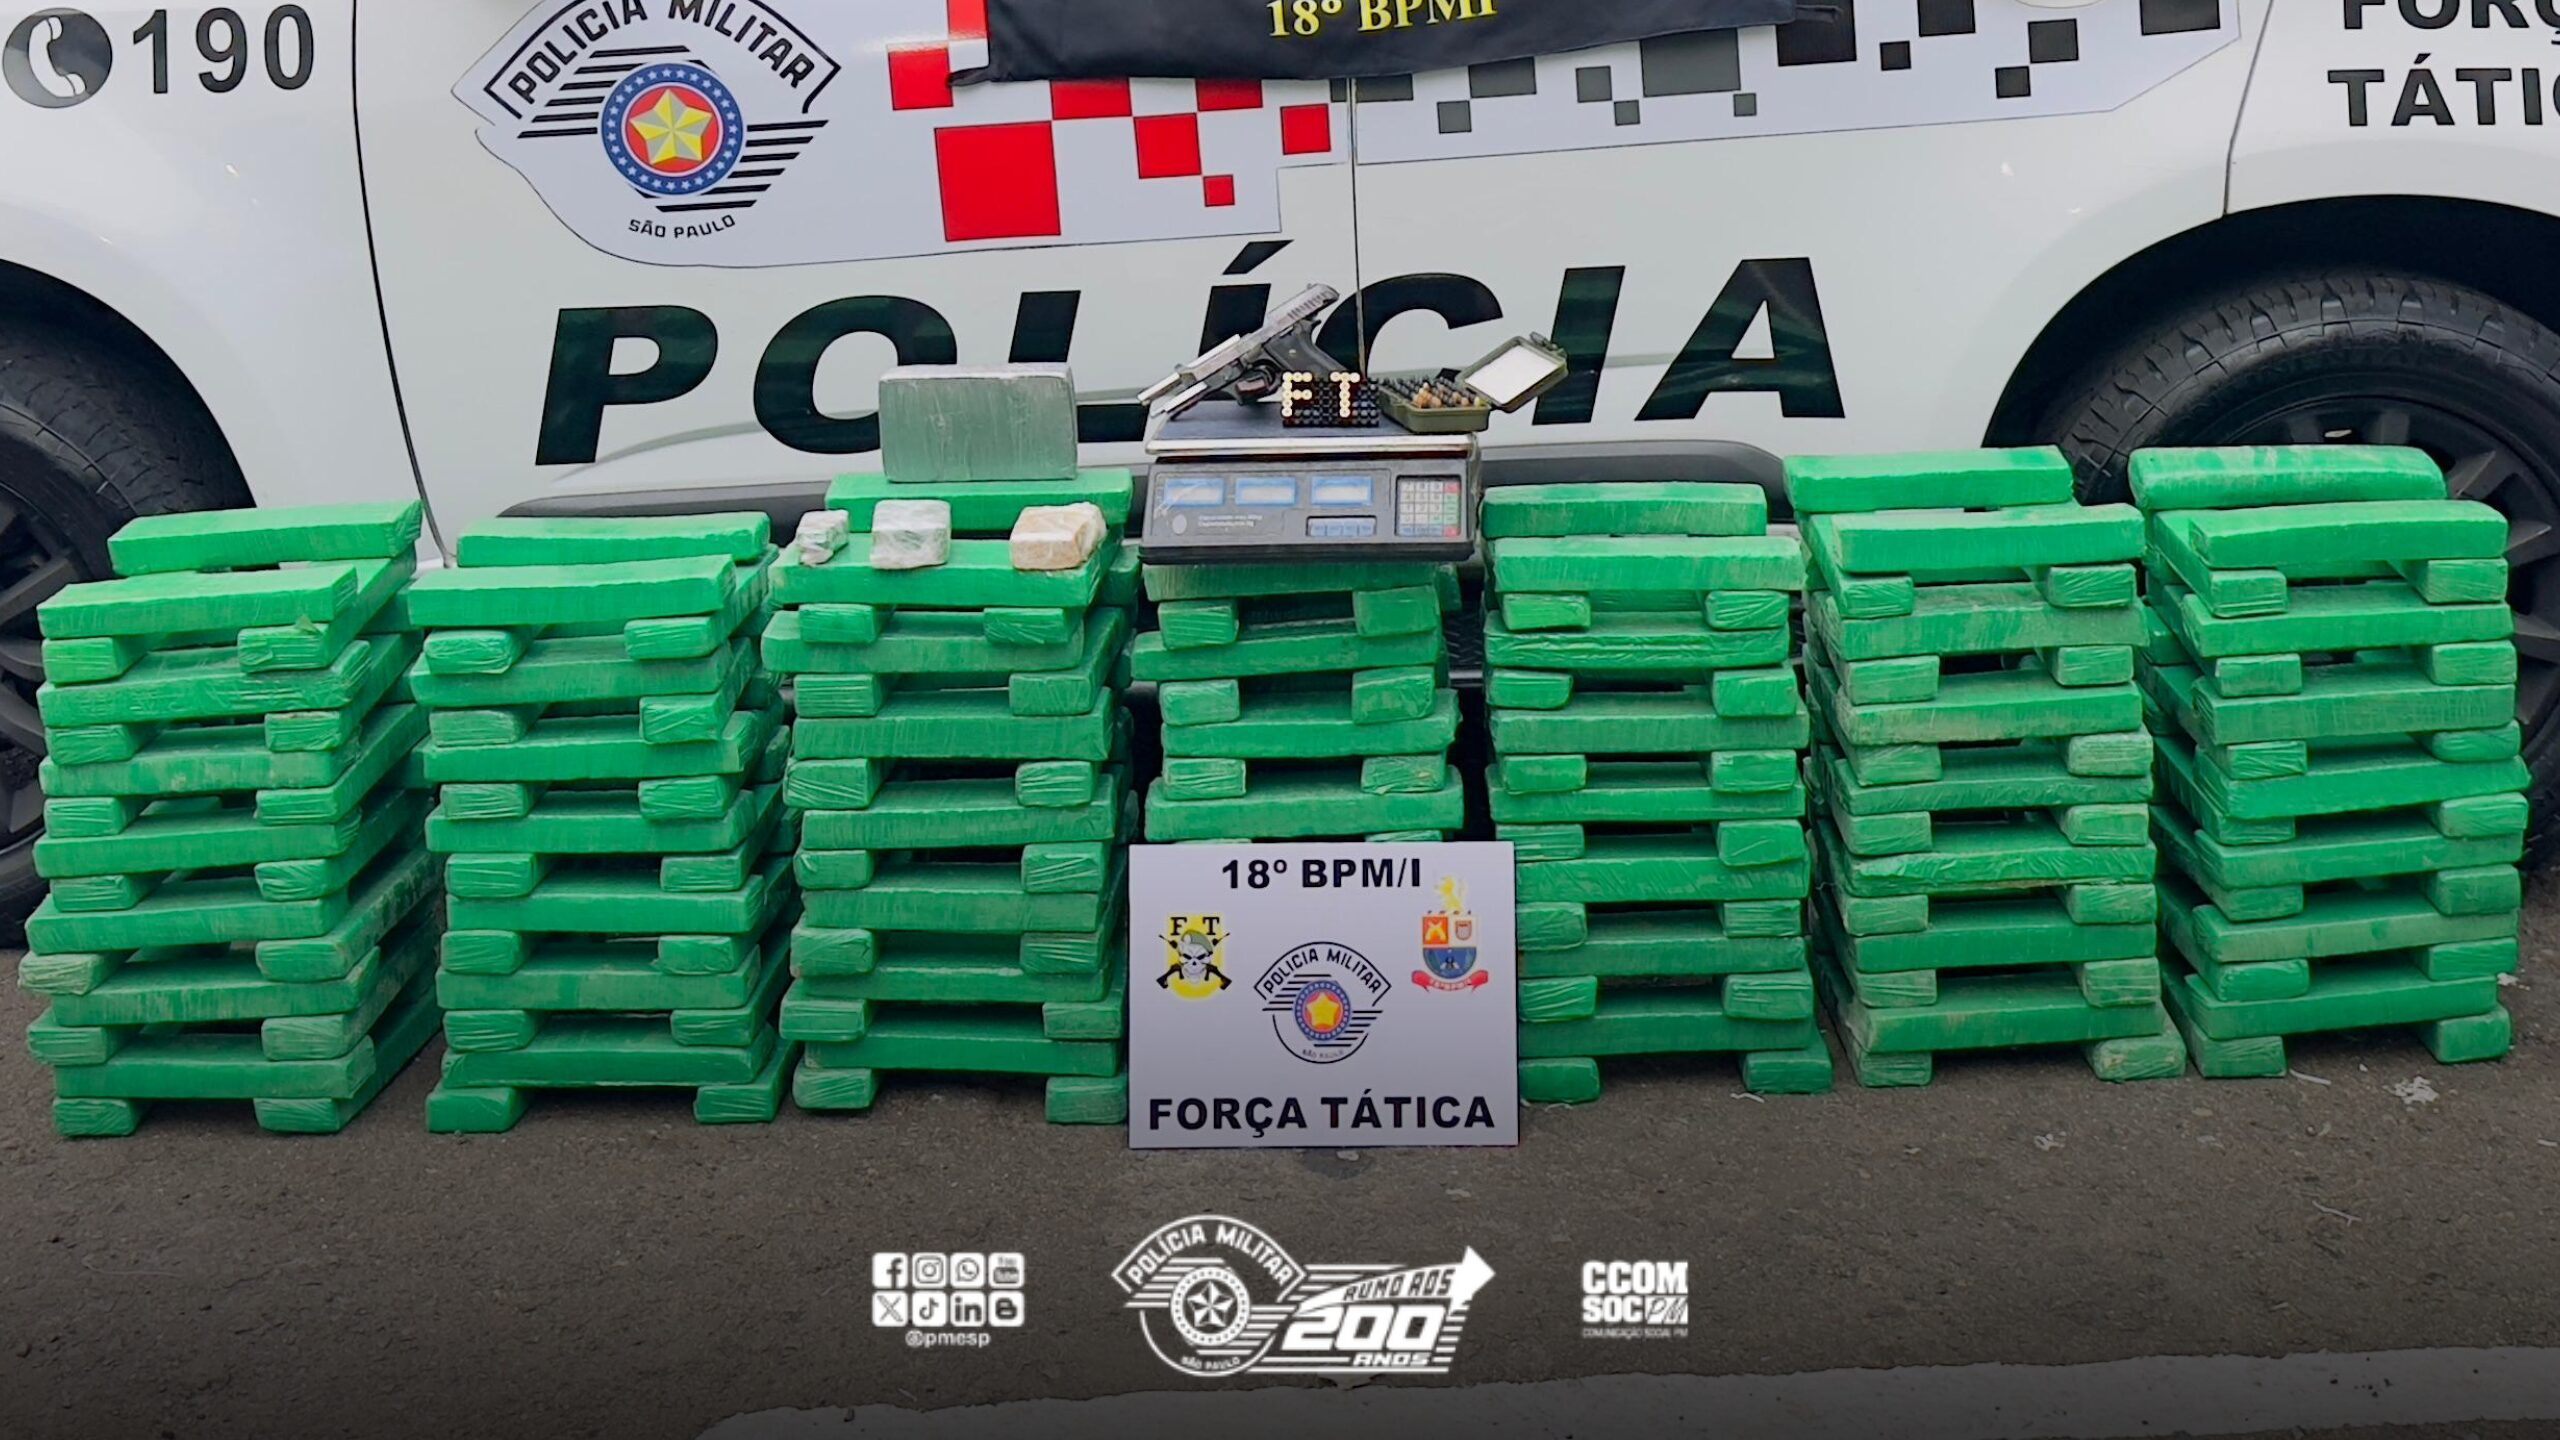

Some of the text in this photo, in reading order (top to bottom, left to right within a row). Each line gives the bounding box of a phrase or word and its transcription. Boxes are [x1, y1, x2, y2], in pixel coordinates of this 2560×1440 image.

[133, 4, 314, 94] 190
[668, 0, 816, 89] MILITAR
[2327, 53, 2560, 126] TÁTI
[628, 214, 736, 239] SÃO PAULO
[1302, 858, 1421, 888] BPM/I
[1326, 948, 1382, 993] MILITAR
[1149, 1089, 1496, 1138] FORÇA TÁTICA
